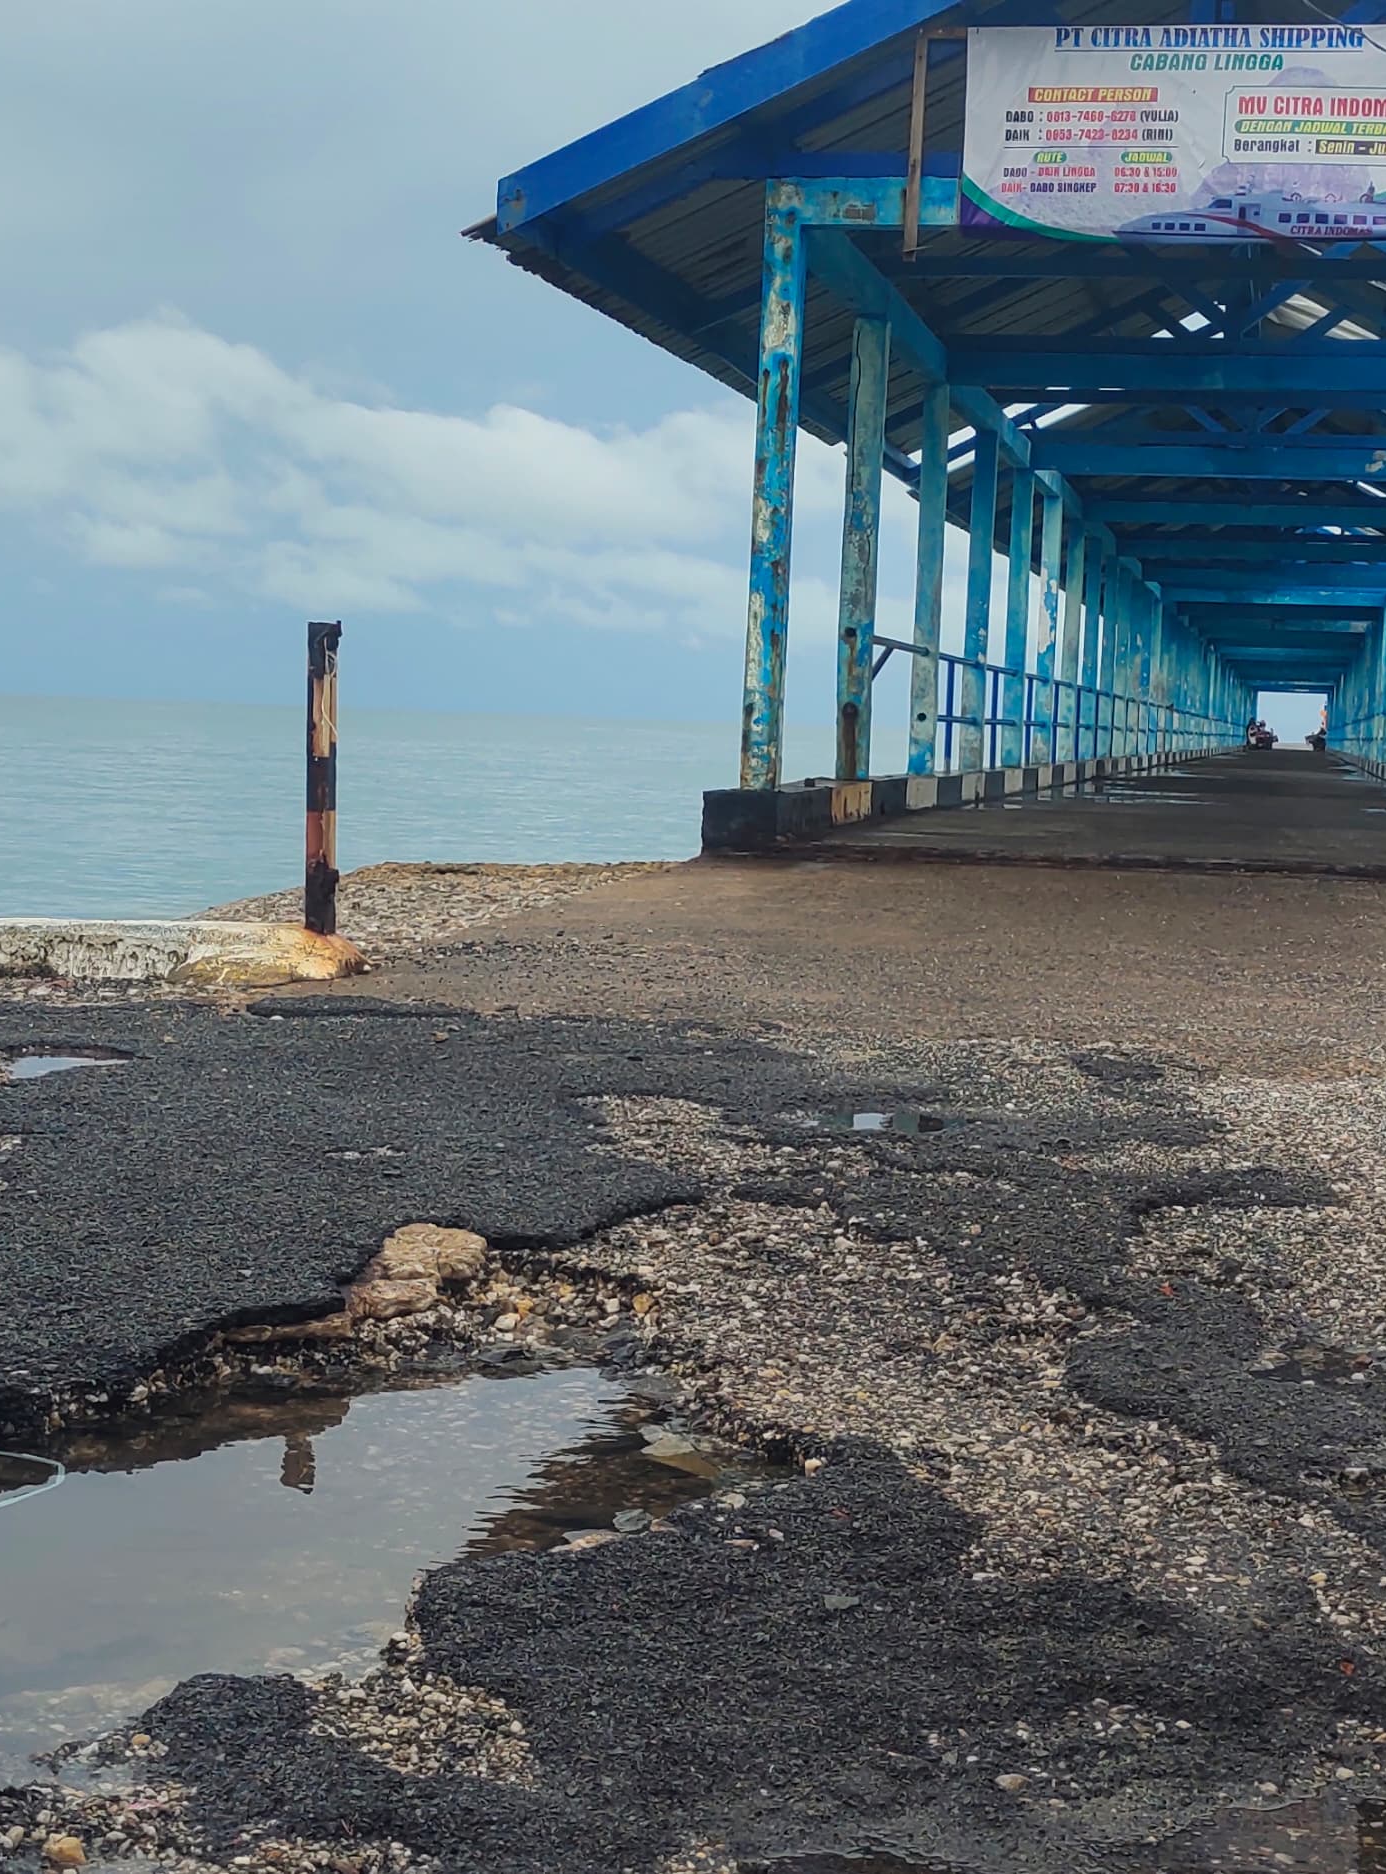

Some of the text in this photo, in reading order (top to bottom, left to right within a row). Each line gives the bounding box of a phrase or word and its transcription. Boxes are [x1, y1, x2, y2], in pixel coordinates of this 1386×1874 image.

[1055, 27, 1363, 48] PT CITRA ADIATHA SHIPPING
[1130, 54, 1284, 71] CABANG LINGGA
[1034, 88, 1152, 102] CONTACT PERSON
[1238, 96, 1267, 115] MV
[1274, 97, 1323, 116] CITRA
[1006, 110, 1034, 122] DABO
[1140, 110, 1179, 122] (YULIA)
[1240, 120, 1293, 132] DENGAN
[1295, 121, 1347, 134] JADWAL
[1005, 129, 1030, 141] DAIK
[1142, 128, 1173, 141] (RINI)
[1234, 139, 1300, 152] Berangkat
[1319, 141, 1355, 154] Senin
[1036, 152, 1063, 163] RUTE
[1124, 152, 1169, 162] JADWAL
[1290, 225, 1321, 234] CITRA
